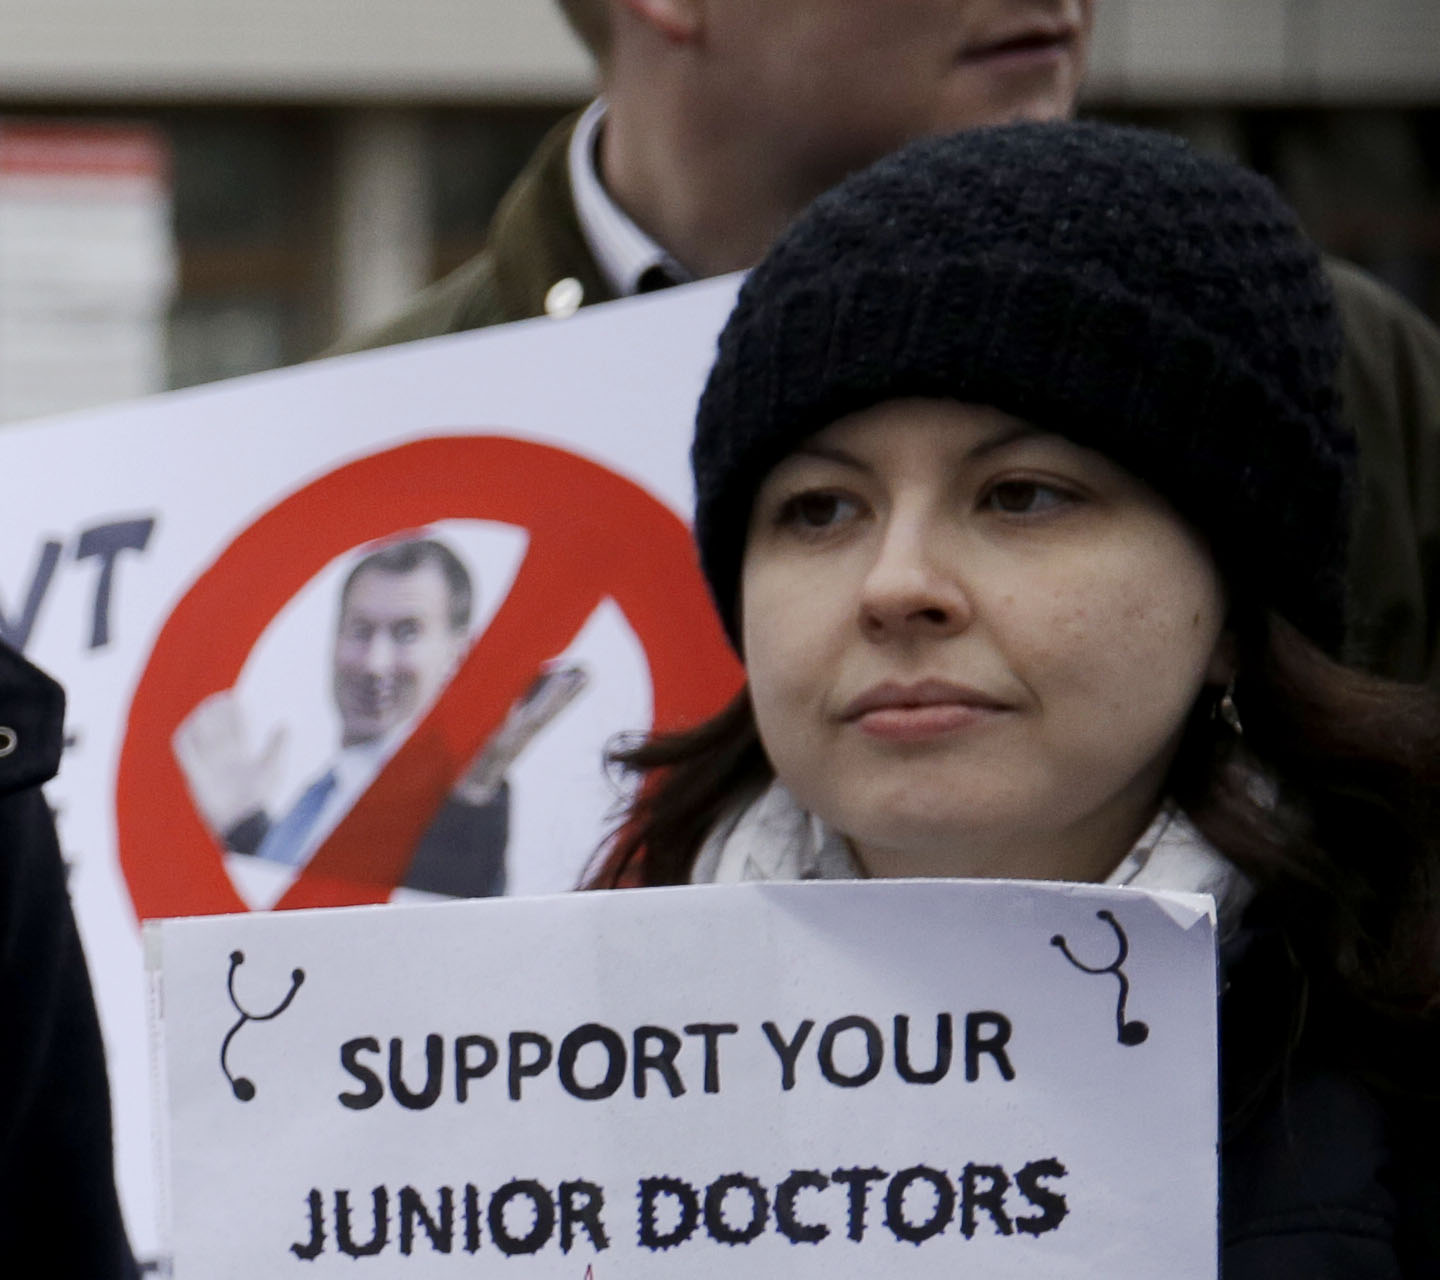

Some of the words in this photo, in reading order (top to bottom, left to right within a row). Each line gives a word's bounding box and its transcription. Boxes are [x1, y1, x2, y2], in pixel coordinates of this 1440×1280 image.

[337, 1021, 738, 1109] SUPPORT
[762, 1010, 1018, 1093] YOUR
[290, 1175, 611, 1261] JUNIOR
[634, 1156, 1070, 1250] DOCTORS
